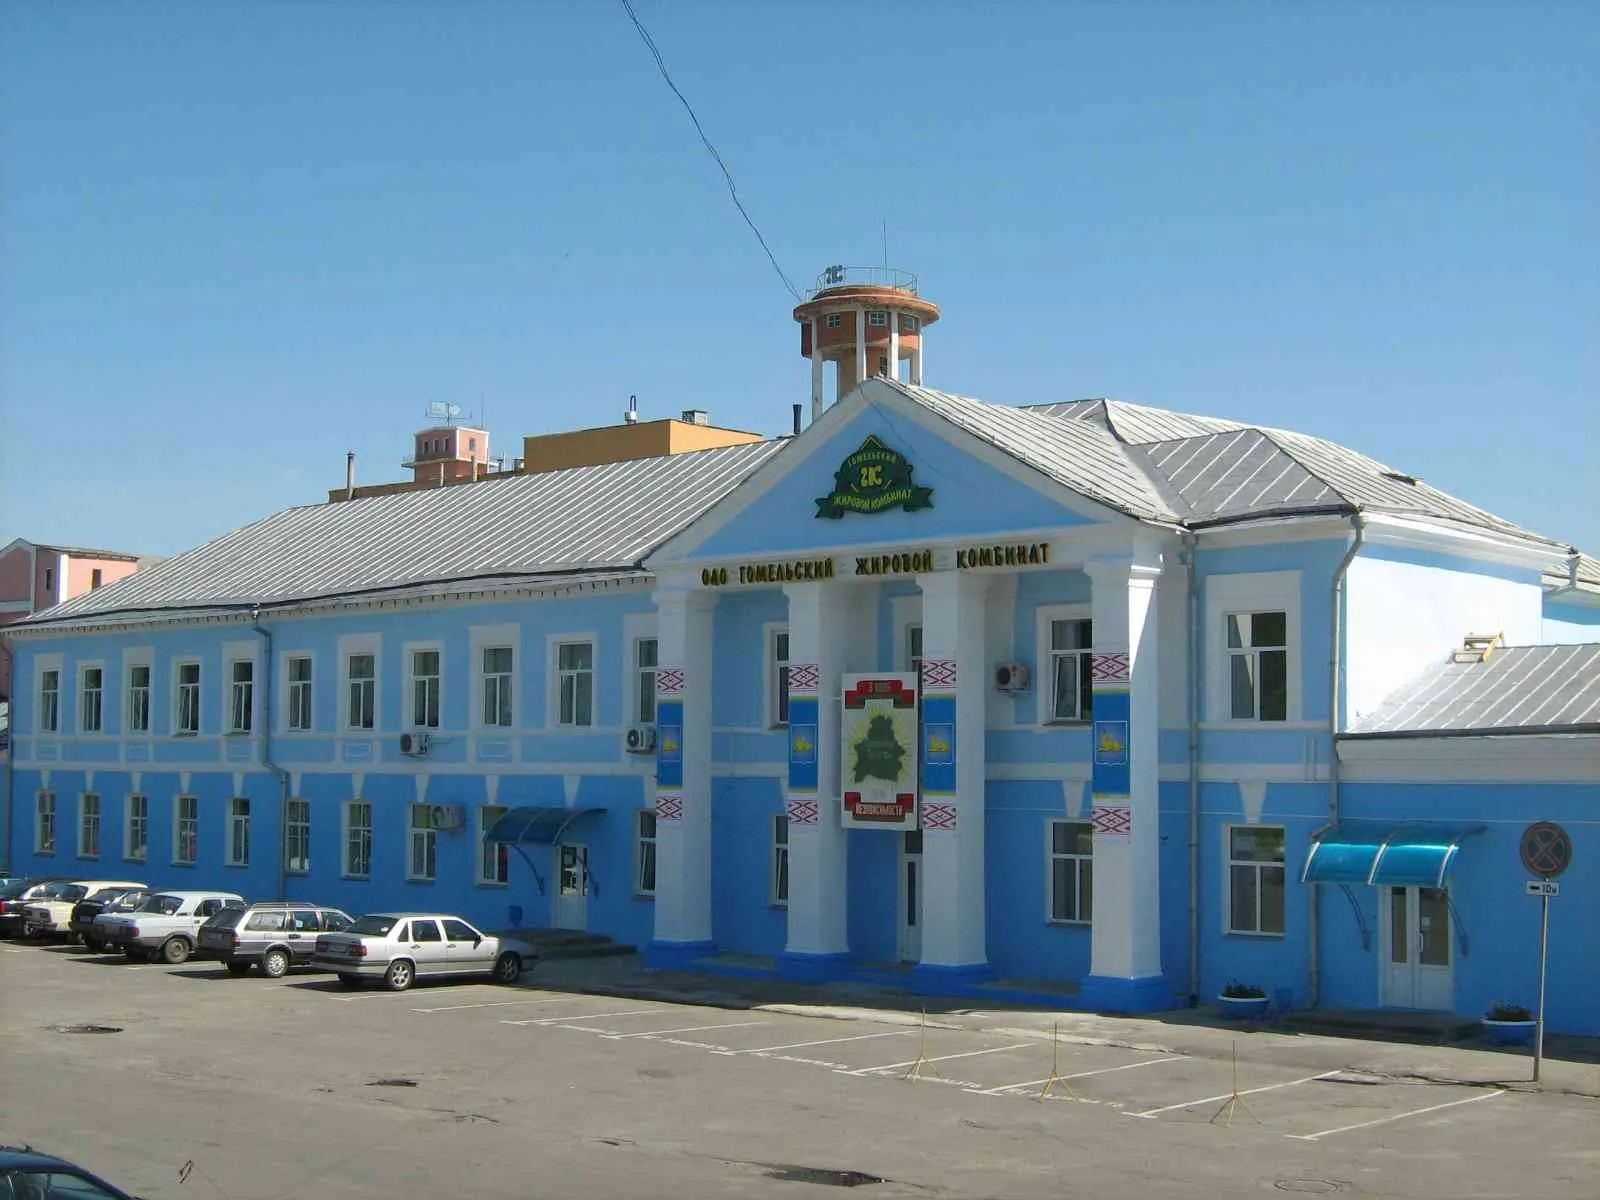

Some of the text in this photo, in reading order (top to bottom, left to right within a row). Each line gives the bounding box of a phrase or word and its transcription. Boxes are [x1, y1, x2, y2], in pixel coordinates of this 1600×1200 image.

[871, 488, 912, 512] КОМБИНАТ
[702, 543, 1050, 586] ОАО ГОМЕЛЬСКИЙ ЖИРОВОЙ КОМБИНАТ
